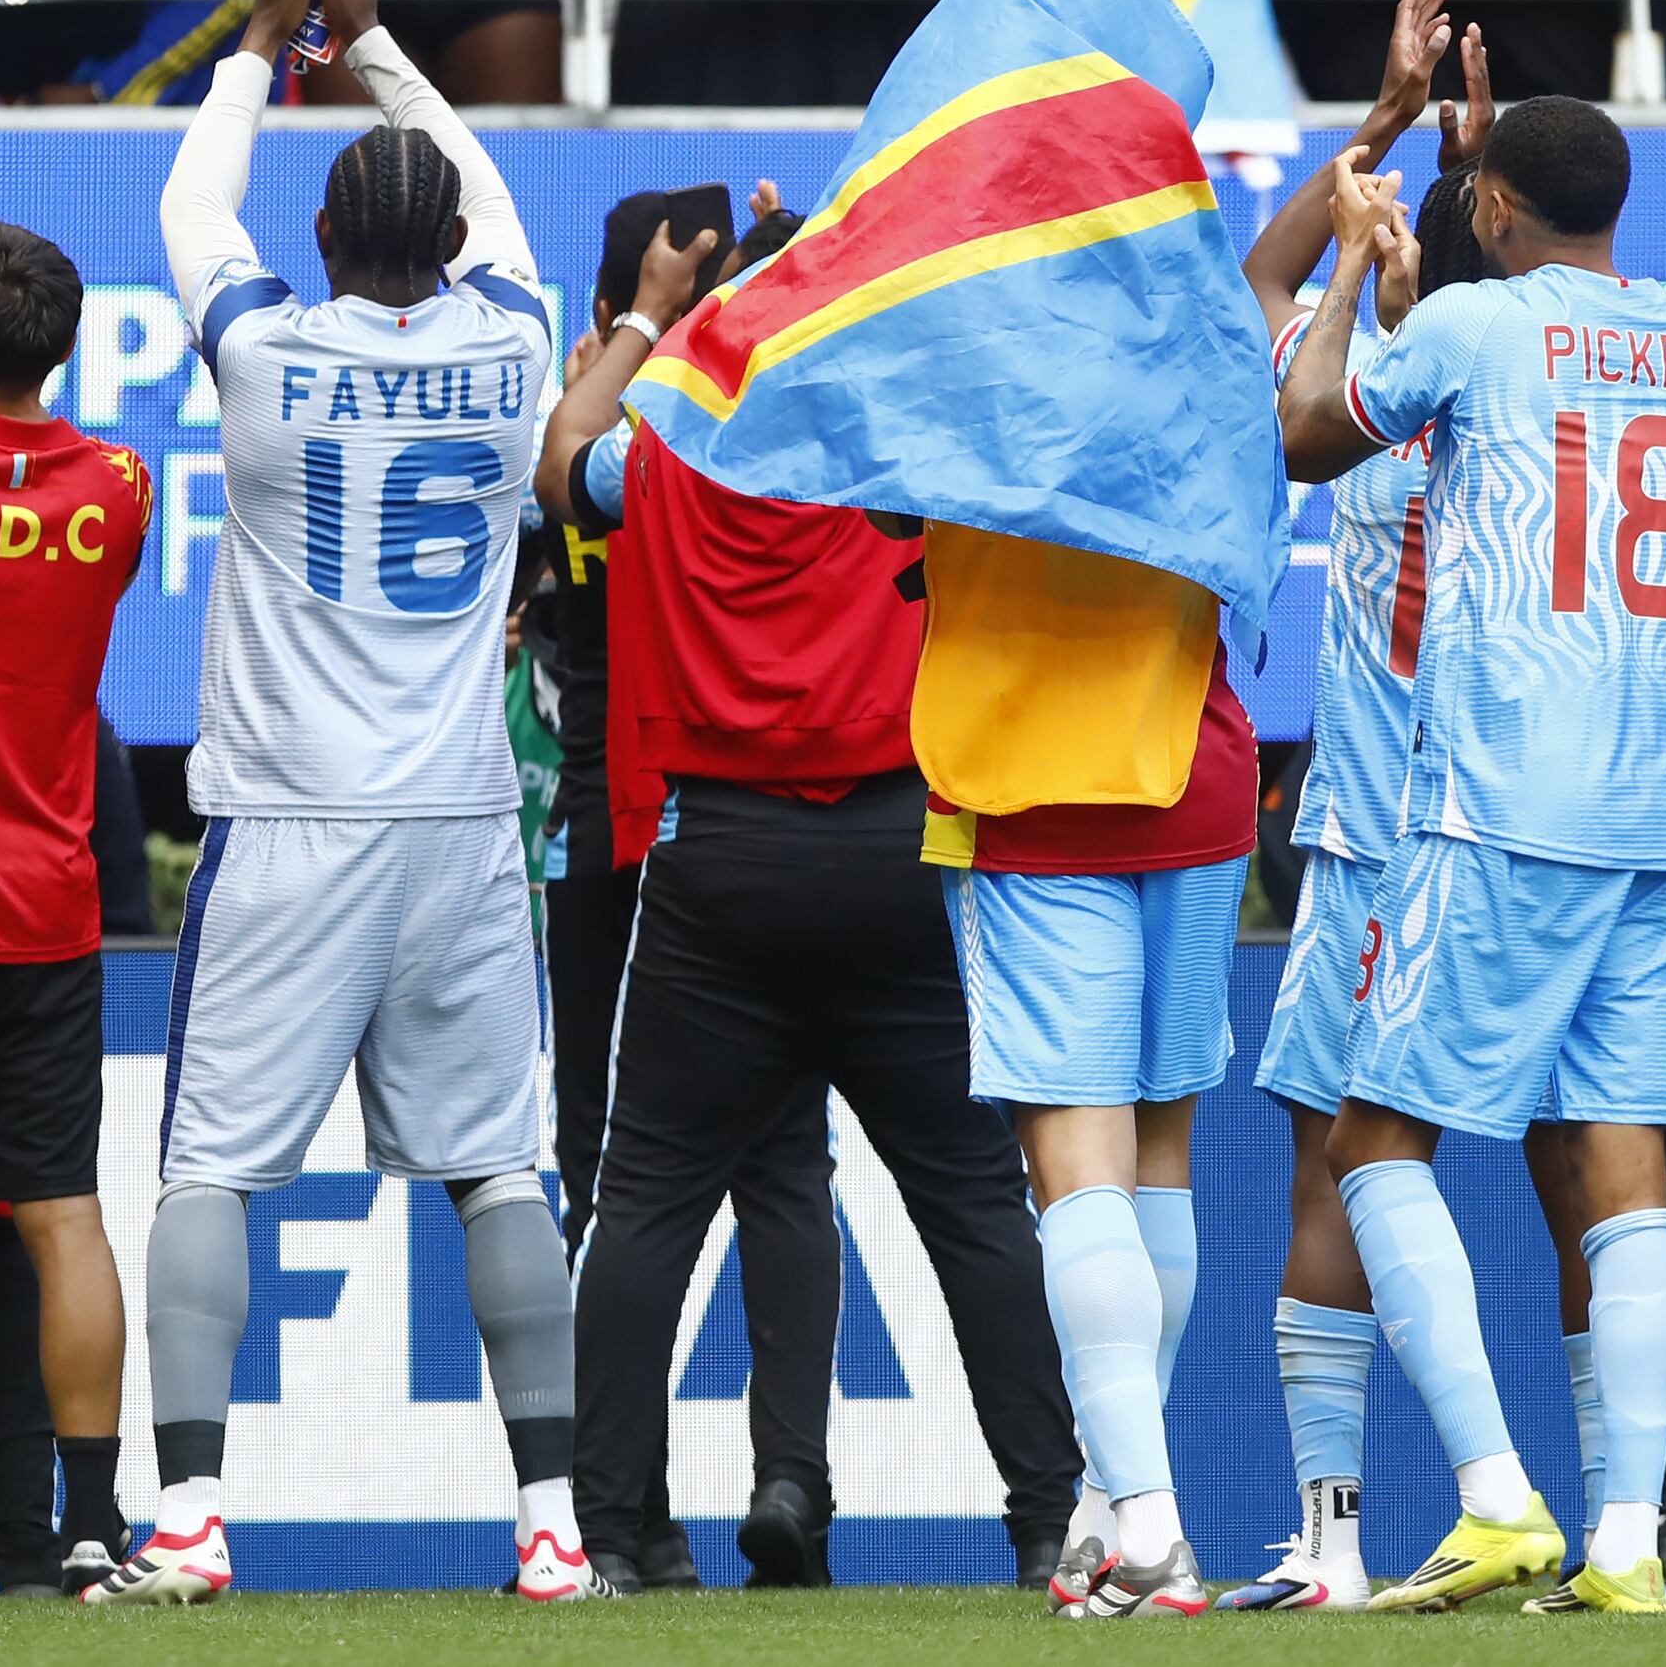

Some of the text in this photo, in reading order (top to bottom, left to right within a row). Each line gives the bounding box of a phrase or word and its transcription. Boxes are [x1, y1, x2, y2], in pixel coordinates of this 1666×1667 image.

[281, 363, 524, 422] FAYULU
[303, 438, 505, 613] 16
[213, 1171, 914, 1402] FIA
